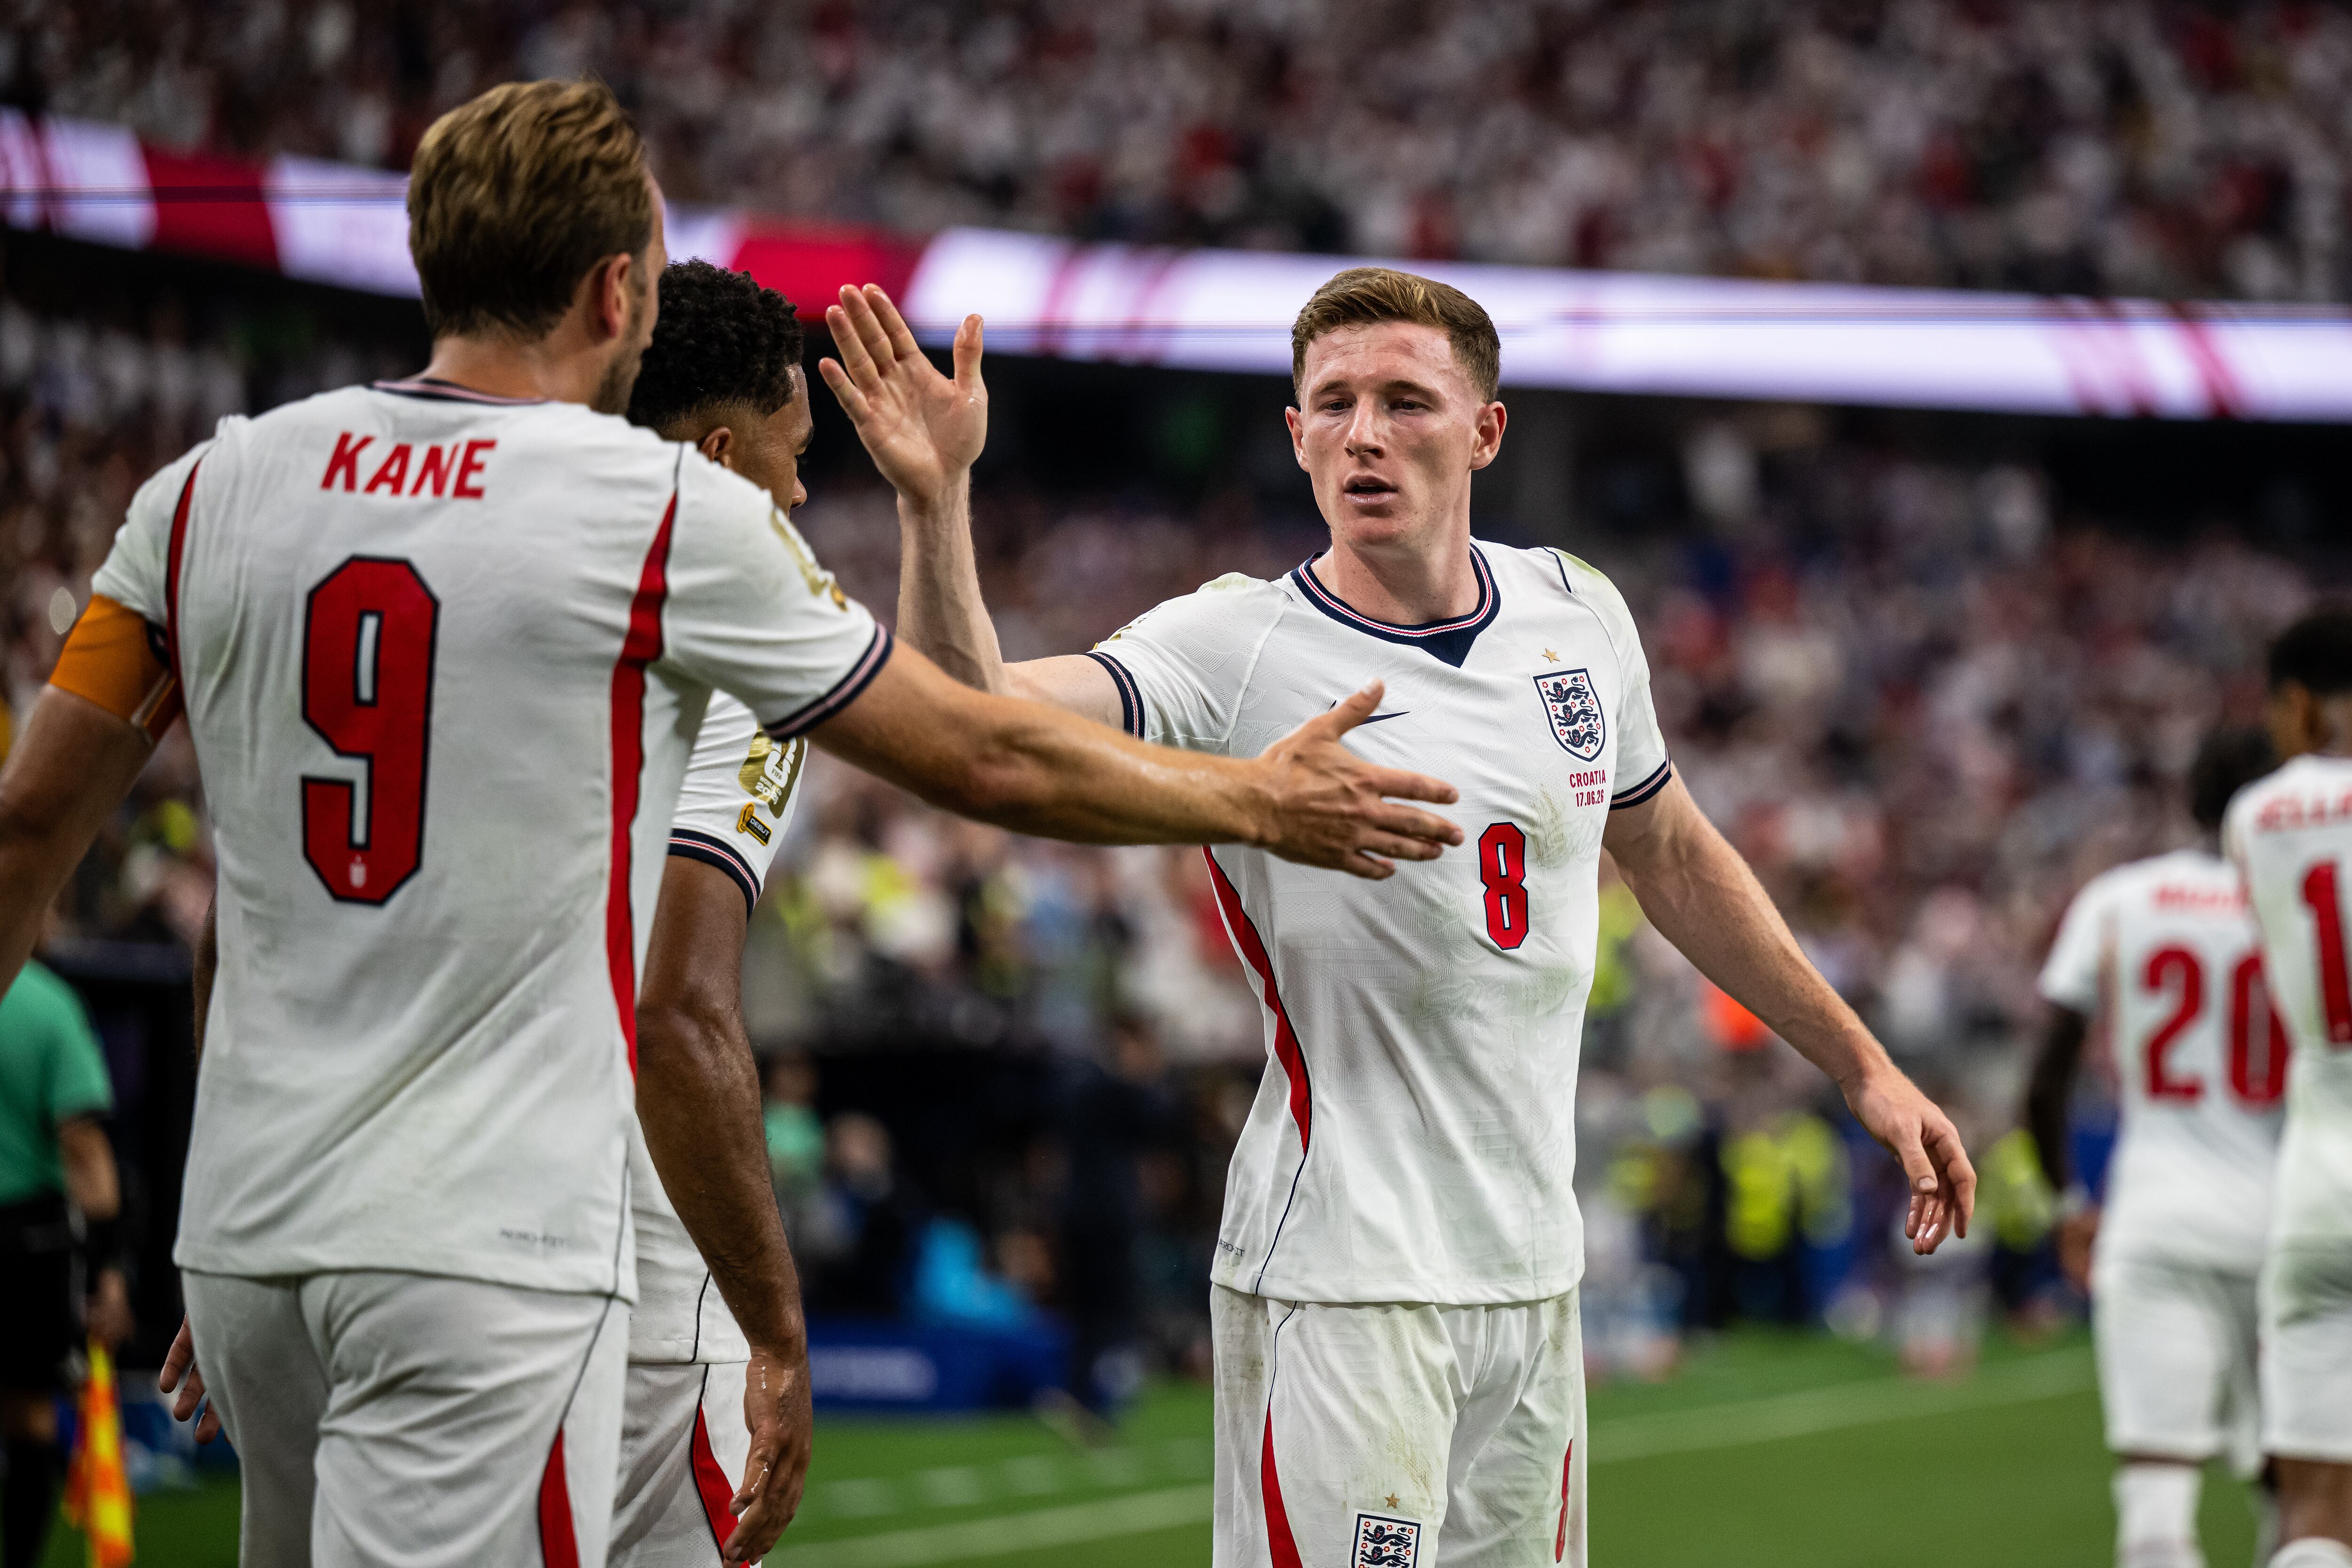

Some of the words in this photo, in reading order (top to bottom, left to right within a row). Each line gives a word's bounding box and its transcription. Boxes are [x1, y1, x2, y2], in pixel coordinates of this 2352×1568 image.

[320, 430, 498, 500] KANE
[301, 554, 441, 907] 9
[771, 768, 782, 780] FIFA
[1569, 769, 1606, 788] CROATIA
[1576, 789, 1604, 807] 17.06.26
[749, 818, 770, 836] DEBUT
[1478, 822, 1529, 951] 8
[2141, 942, 2290, 1108] 20
